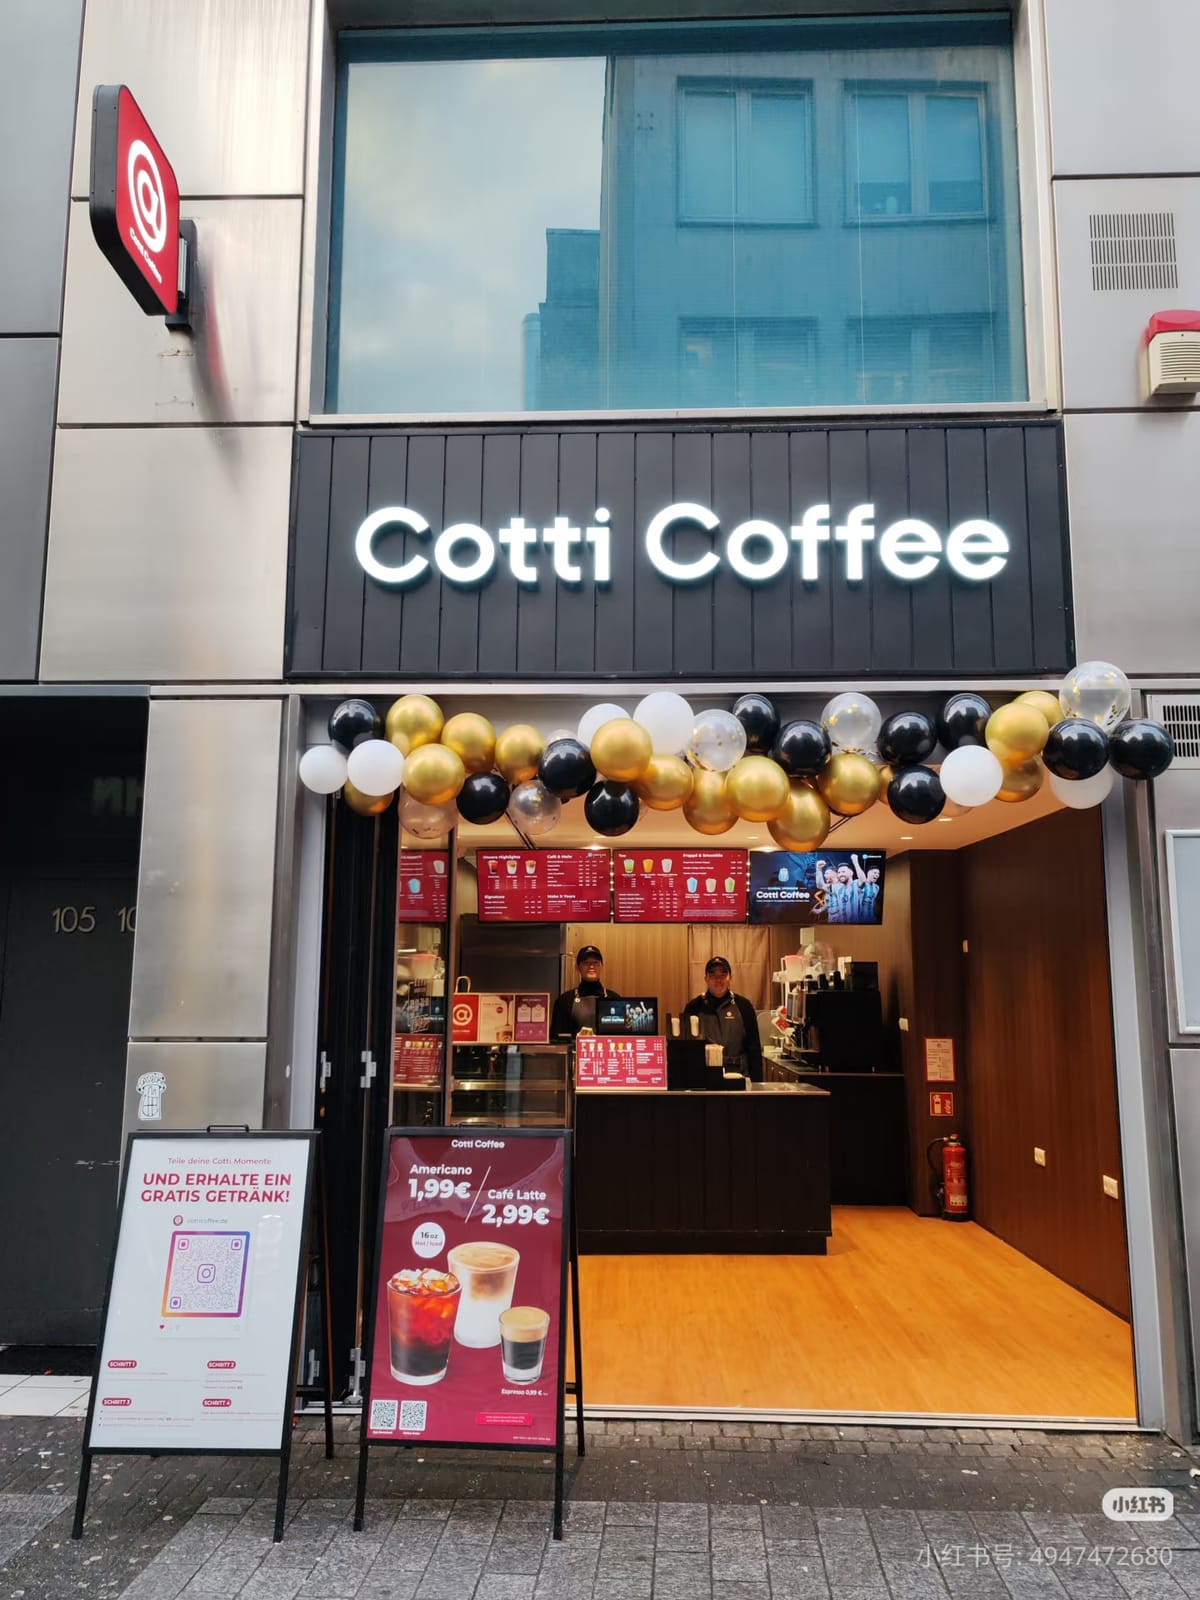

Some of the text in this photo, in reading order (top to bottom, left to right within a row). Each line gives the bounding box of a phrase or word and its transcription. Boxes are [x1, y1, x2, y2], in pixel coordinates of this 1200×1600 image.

[354, 503, 1010, 583] Cotti Coffee
[756, 890, 810, 898] Cotti Coffee
[52, 906, 96, 933] 105
[451, 1140, 505, 1148] Cotti Coffee
[168, 1157, 272, 1165] Teile deine Cotti Momente
[410, 1164, 473, 1175] Americano
[143, 1173, 292, 1186] UND ERHALTE EIN
[141, 1186, 290, 1203] GRATIS GETRÄNK!
[408, 1178, 472, 1202] 1,99€
[487, 1188, 547, 1200] Café Latte
[481, 1203, 550, 1228] 2,99€
